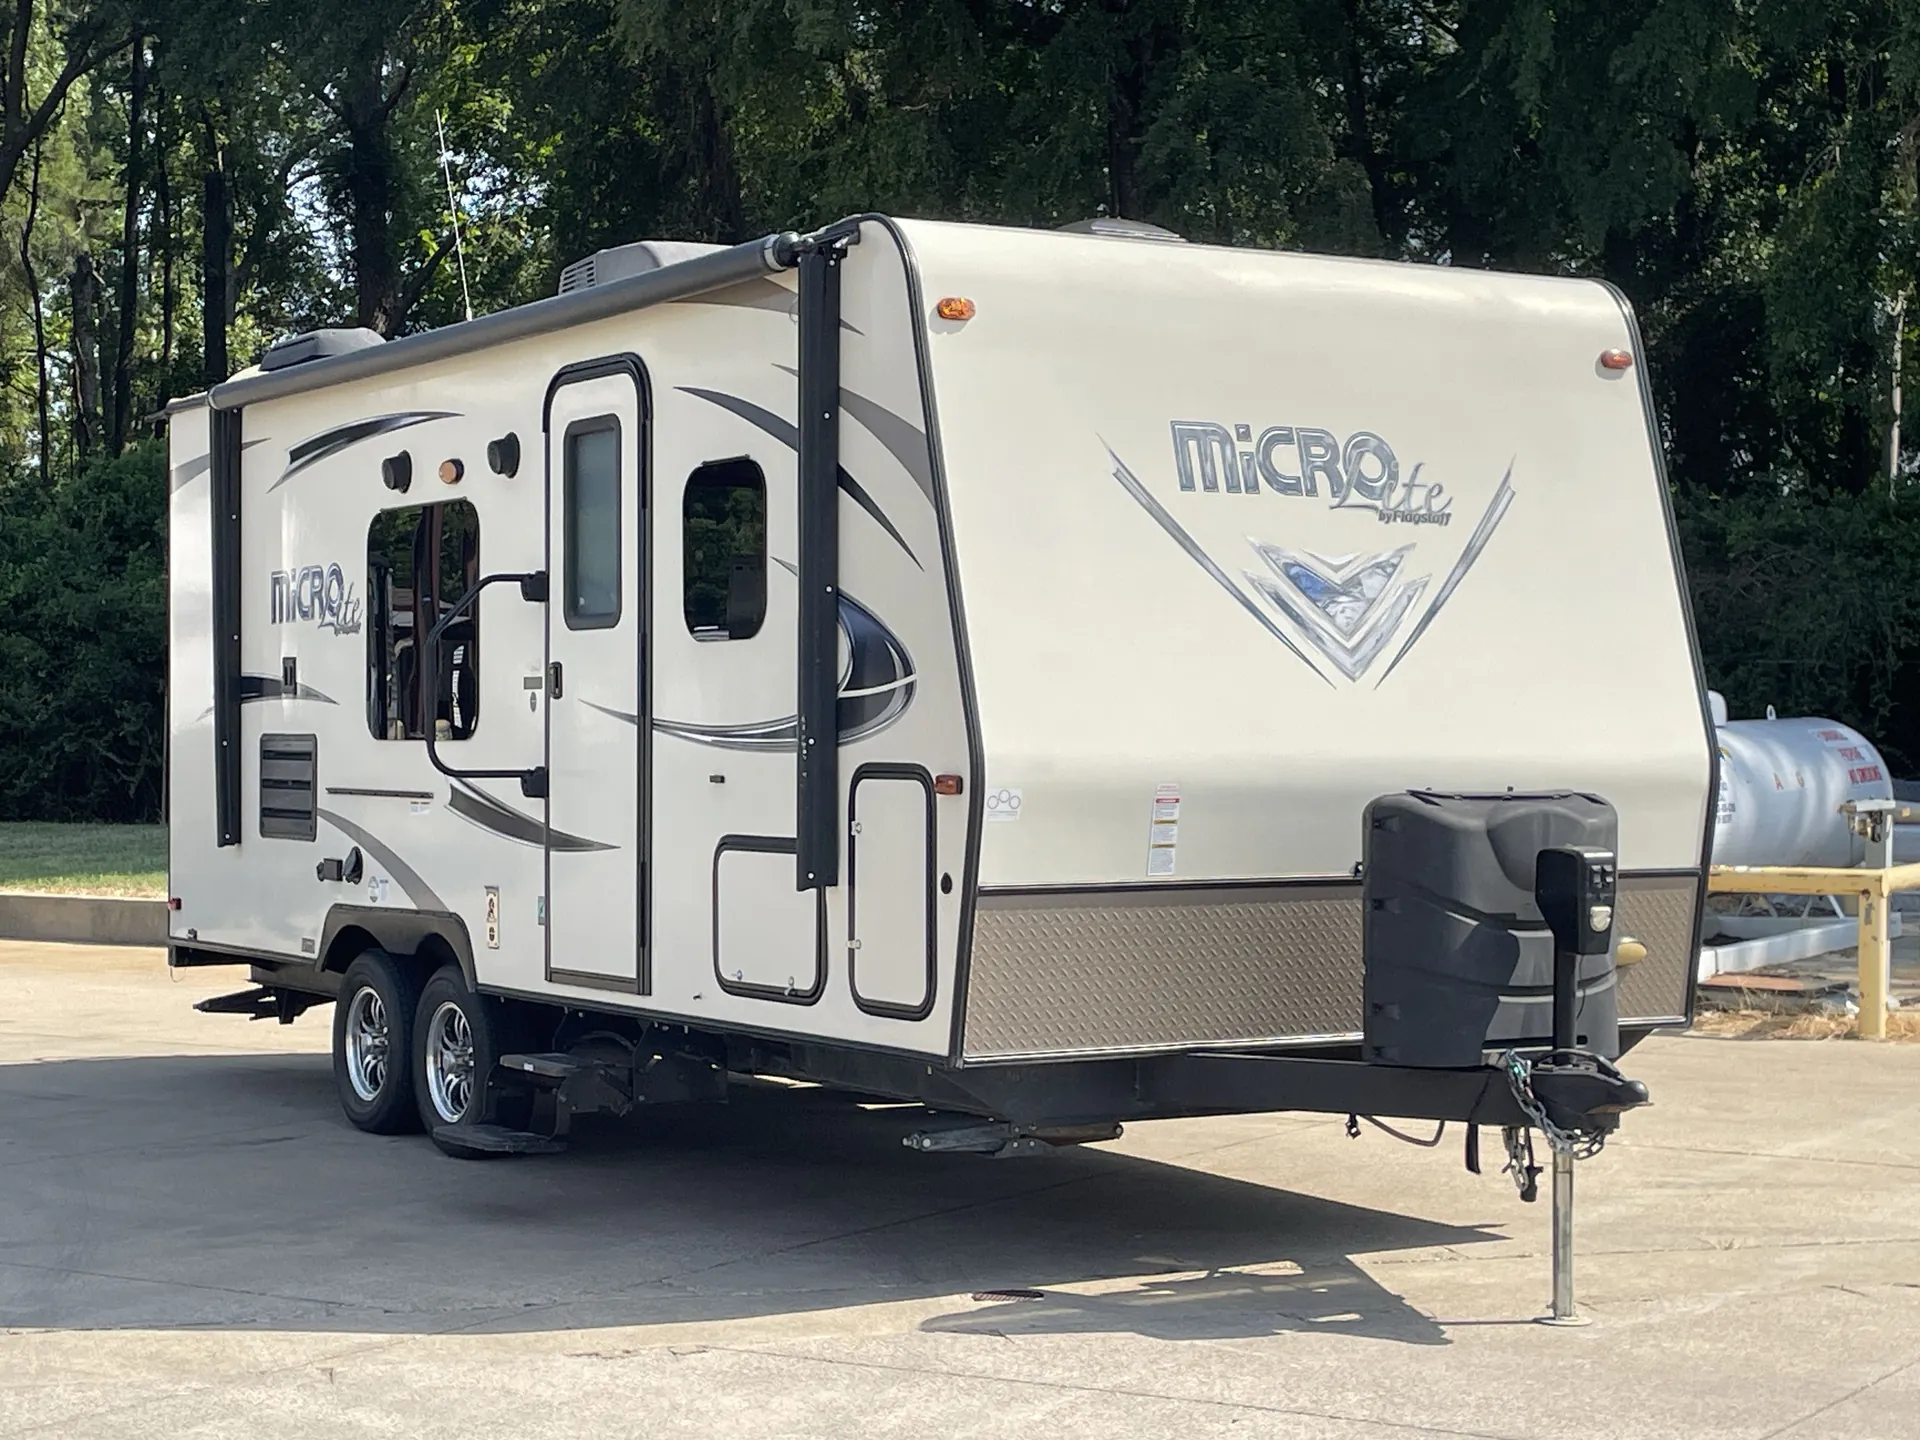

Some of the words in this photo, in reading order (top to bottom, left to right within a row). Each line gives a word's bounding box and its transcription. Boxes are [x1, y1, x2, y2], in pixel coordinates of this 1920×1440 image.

[1329, 449, 1454, 513] Lite
[1378, 510, 1393, 524] by
[1393, 511, 1452, 526] Flagstaff
